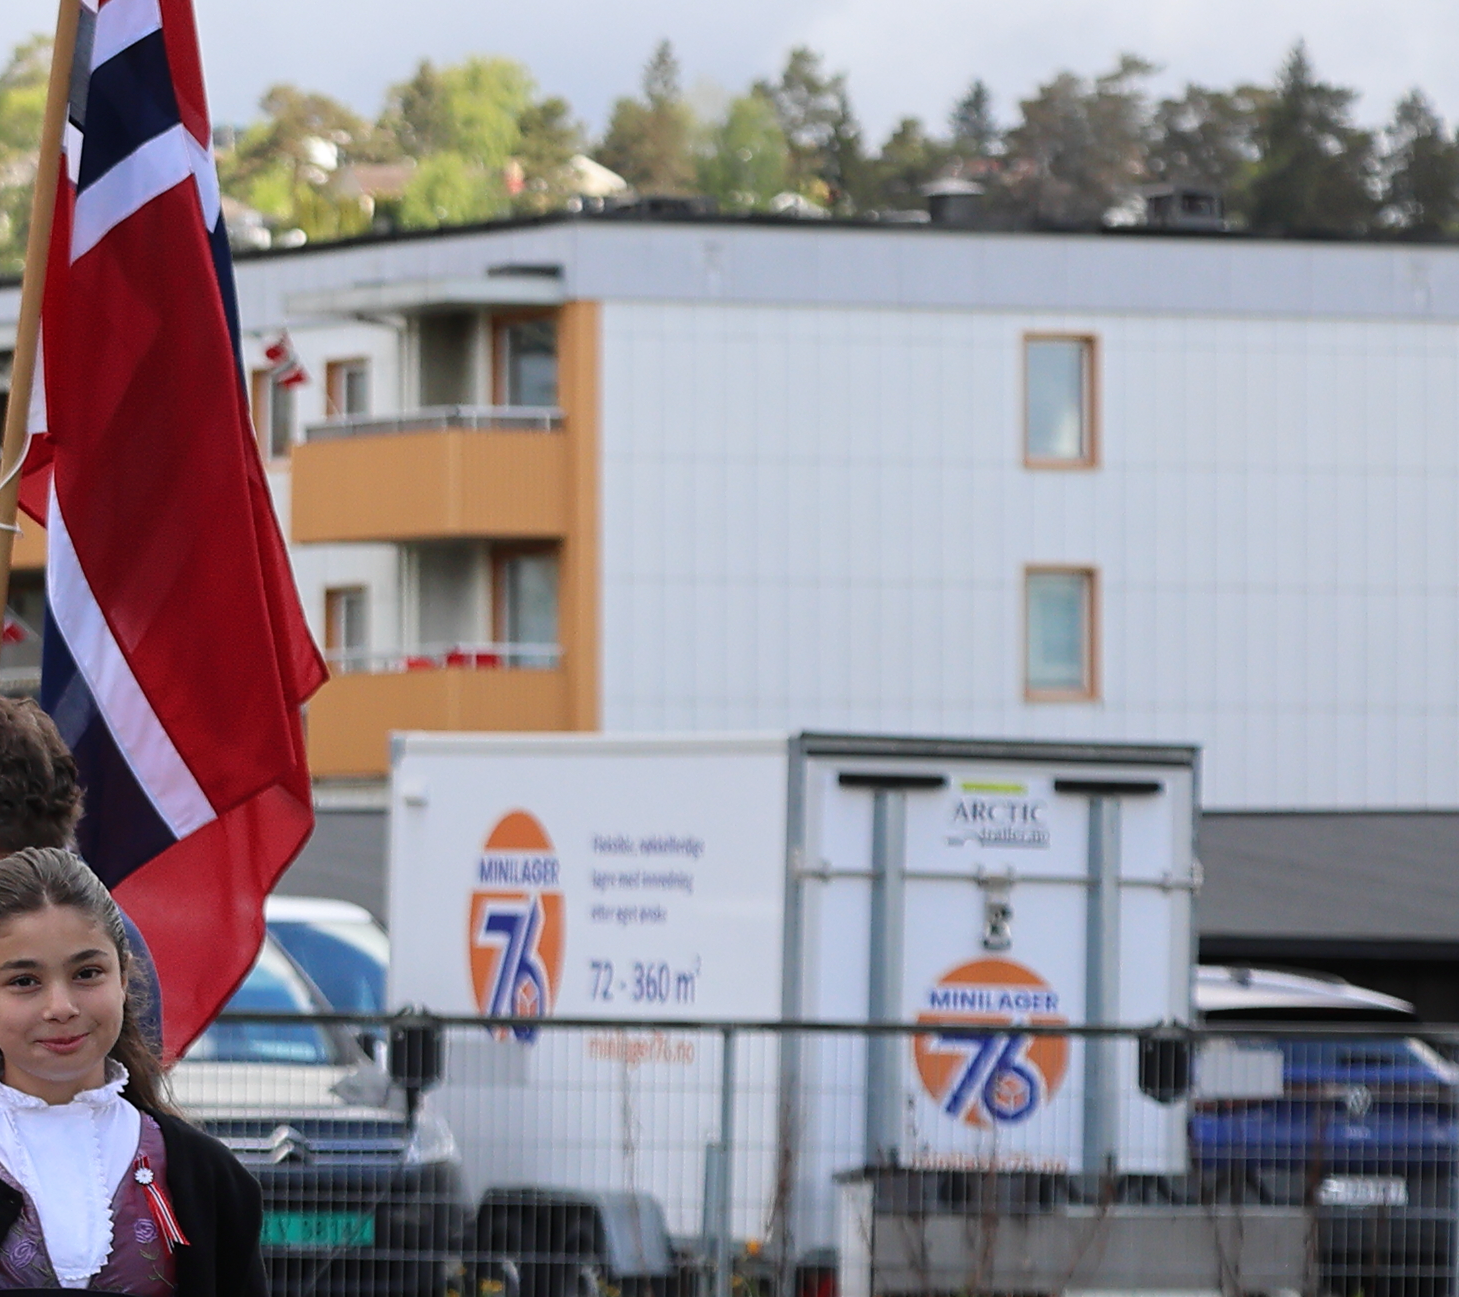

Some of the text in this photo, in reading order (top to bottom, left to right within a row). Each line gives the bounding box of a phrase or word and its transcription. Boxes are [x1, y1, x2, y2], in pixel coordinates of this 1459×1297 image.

[953, 800, 1045, 822] ARCTIC
[479, 858, 560, 885] MINILAGER
[482, 897, 549, 1044] 76
[590, 960, 614, 1001] 72
[633, 961, 671, 1003] 360
[929, 989, 1059, 1011] MINILAGER
[935, 1028, 1041, 1122] 76
